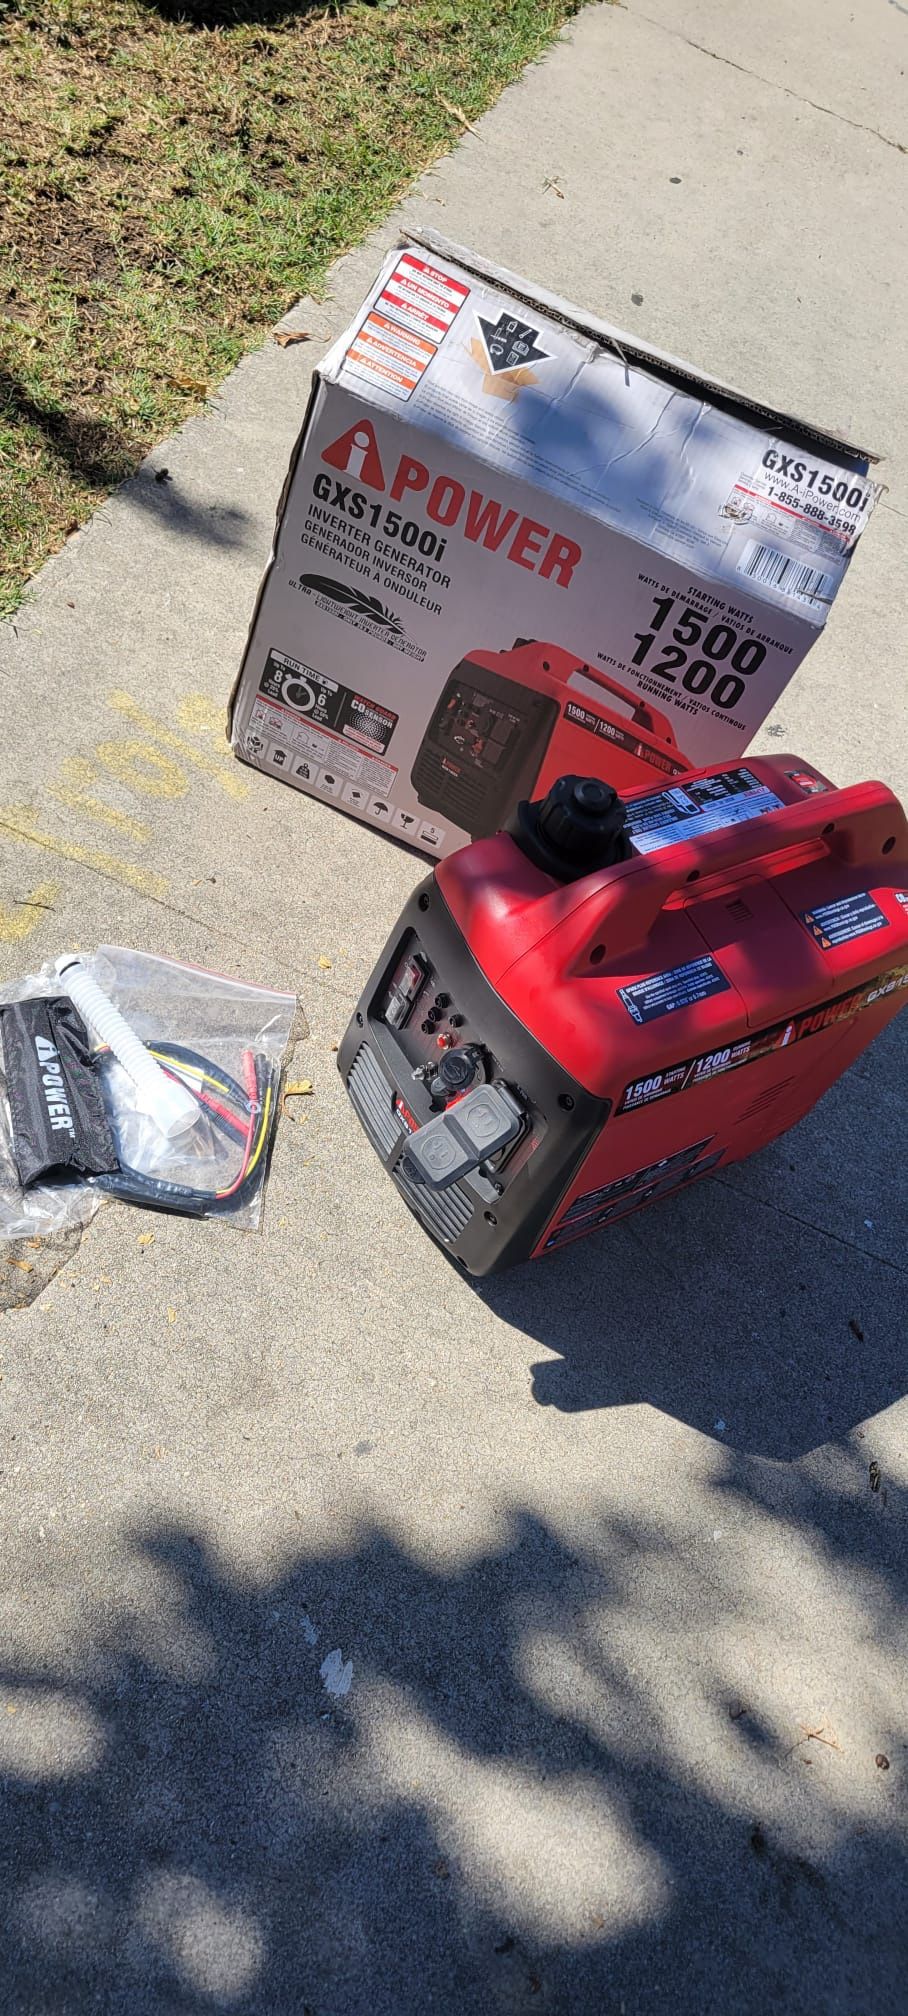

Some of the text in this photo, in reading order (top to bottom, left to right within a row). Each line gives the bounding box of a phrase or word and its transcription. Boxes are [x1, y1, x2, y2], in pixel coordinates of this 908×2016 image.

[406, 280, 418, 291] UN
[417, 286, 449, 309] MOMENTO
[430, 270, 448, 283] STOP
[372, 340, 417, 368] ADVERTENCIA
[388, 323, 421, 346] WARNING
[367, 358, 403, 382] ATTENTION
[762, 449, 871, 512] GXS1500i
[764, 471, 861, 523] www.A-iPower.com
[312, 473, 448, 562] GXS1500i
[389, 454, 582, 589] POWER
[767, 486, 857, 536] 1-855-888-3598
[304, 519, 428, 592] GENERADOR INVERSOR
[308, 503, 451, 589] INVERTER GENERATOR
[300, 533, 371, 578] GÉNÉRATEUR
[383, 577, 442, 616] ONDULEUR
[637, 573, 659, 589] WATTS
[660, 584, 670, 594] DE
[671, 589, 714, 616] DÉMARRAGE
[720, 615, 745, 631] VATIOS
[746, 627, 756, 636] DE
[756, 632, 794, 655] ARRANQUE
[687, 586, 754, 624] STARTING WATTS
[649, 597, 767, 676] 1500
[273, 670, 284, 683] 8
[283, 657, 321, 682] RUN TIME
[596, 651, 617, 667] WATTS
[617, 661, 626, 671] DE
[626, 665, 683, 698] FONCTIONNEMENT
[689, 697, 711, 713] VATIOS
[631, 632, 746, 710] 1200
[317, 694, 327, 706] 6
[364, 709, 393, 729] SENSOR
[637, 680, 699, 716] RUNNING WATTS
[567, 704, 586, 720] 1500
[599, 721, 616, 737] 1200
[274, 754, 285, 762] UP
[625, 1075, 663, 1100] 1500
[697, 1048, 731, 1072] 1200
